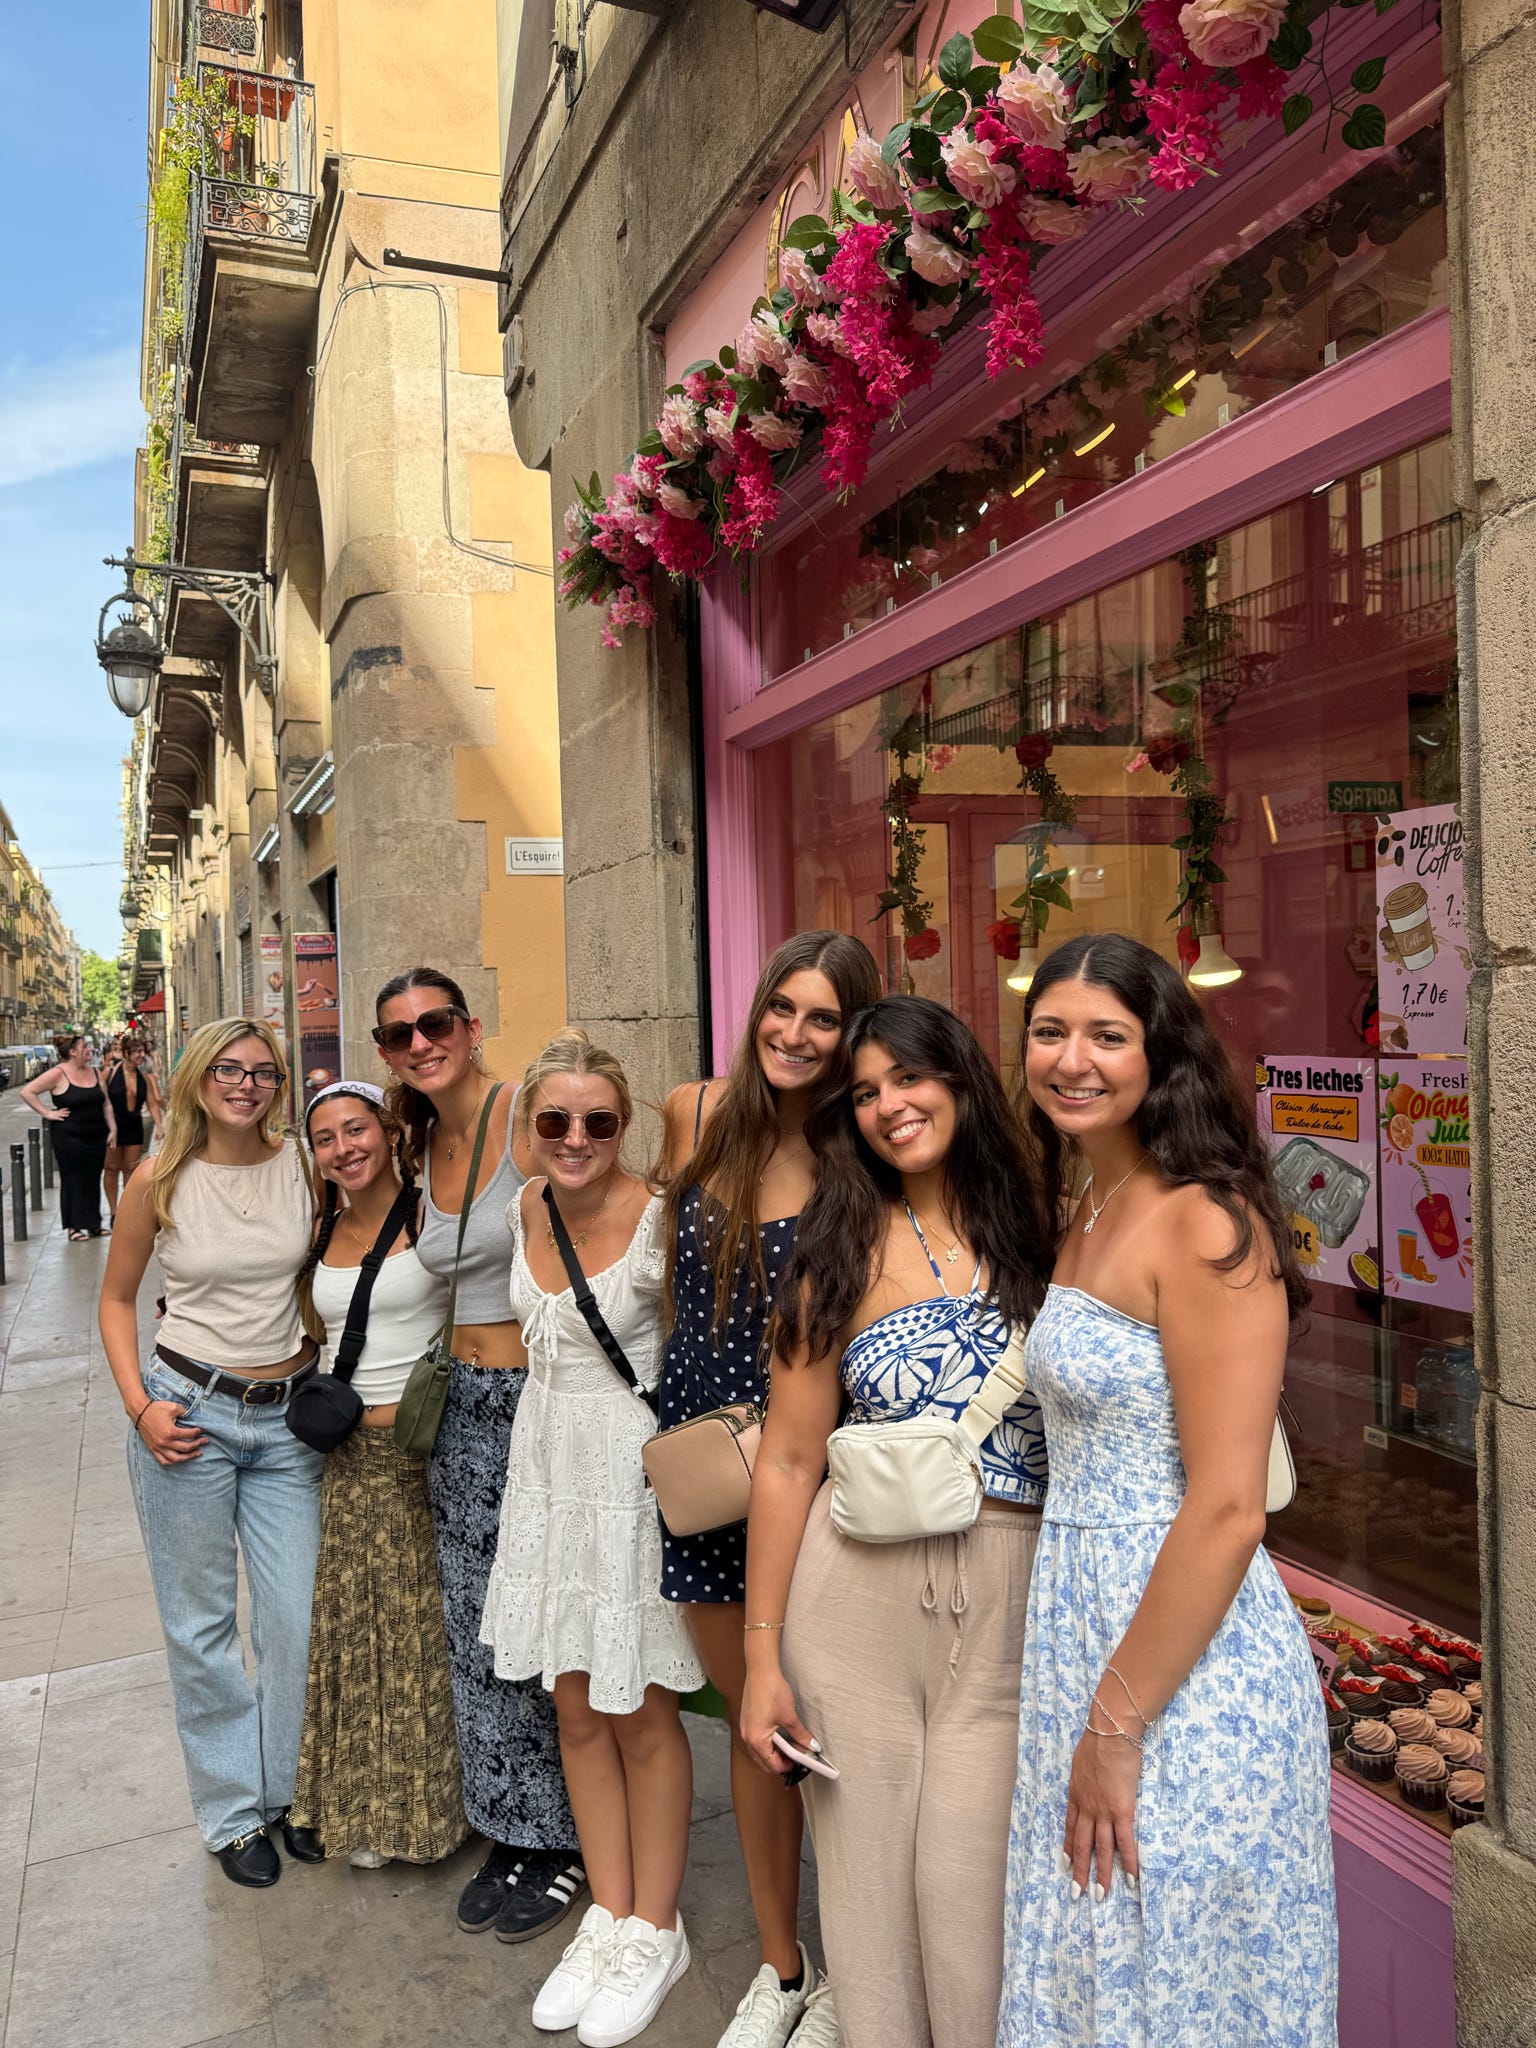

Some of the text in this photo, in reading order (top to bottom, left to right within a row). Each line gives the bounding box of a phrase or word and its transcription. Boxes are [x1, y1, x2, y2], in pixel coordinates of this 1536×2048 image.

[1333, 787, 1398, 807] SORTIDA
[1266, 1065, 1364, 1093] Tres leches
[1286, 1116, 1345, 1131] Dulce de leche
[1421, 1146, 1443, 1163] 100%
